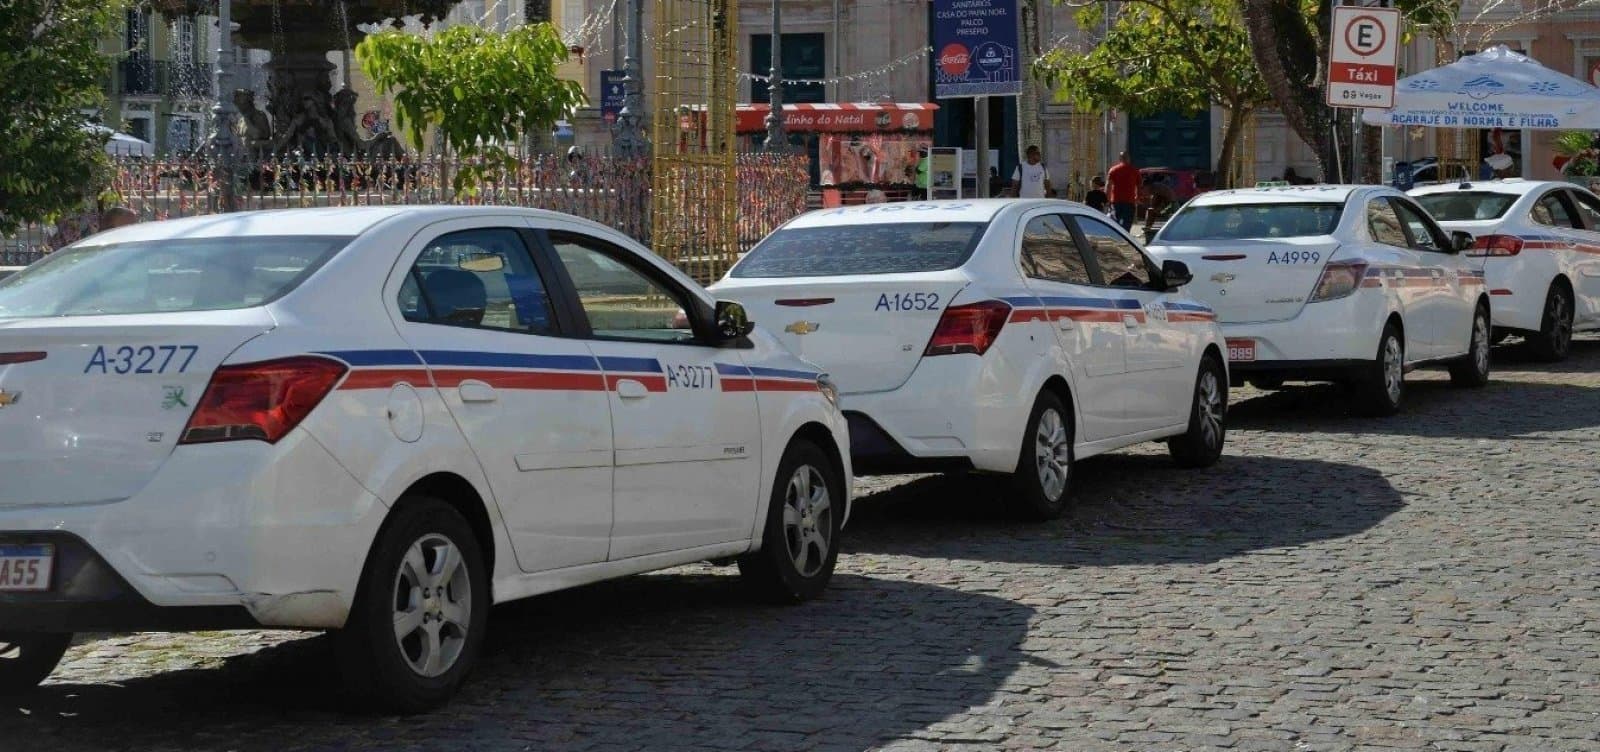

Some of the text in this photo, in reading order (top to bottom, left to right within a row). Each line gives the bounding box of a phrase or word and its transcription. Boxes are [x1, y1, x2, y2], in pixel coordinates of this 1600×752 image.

[937, 10, 955, 19] CASA
[956, 10, 967, 18] DO
[988, 8, 1007, 16] NOEL
[961, 18, 984, 27] PALCO
[1358, 24, 1373, 48] E
[1347, 66, 1378, 82] Táxi
[1448, 101, 1504, 112] WELCOME
[817, 113, 831, 125] do
[834, 113, 864, 126] Natal
[1444, 115, 1458, 125] DA
[1464, 116, 1503, 127] NORMA
[1520, 117, 1559, 128] FILHAS
[1267, 250, 1320, 264] A-4999
[875, 292, 940, 311] A-1652
[84, 345, 199, 374] A-3277
[667, 364, 713, 390] A-3277
